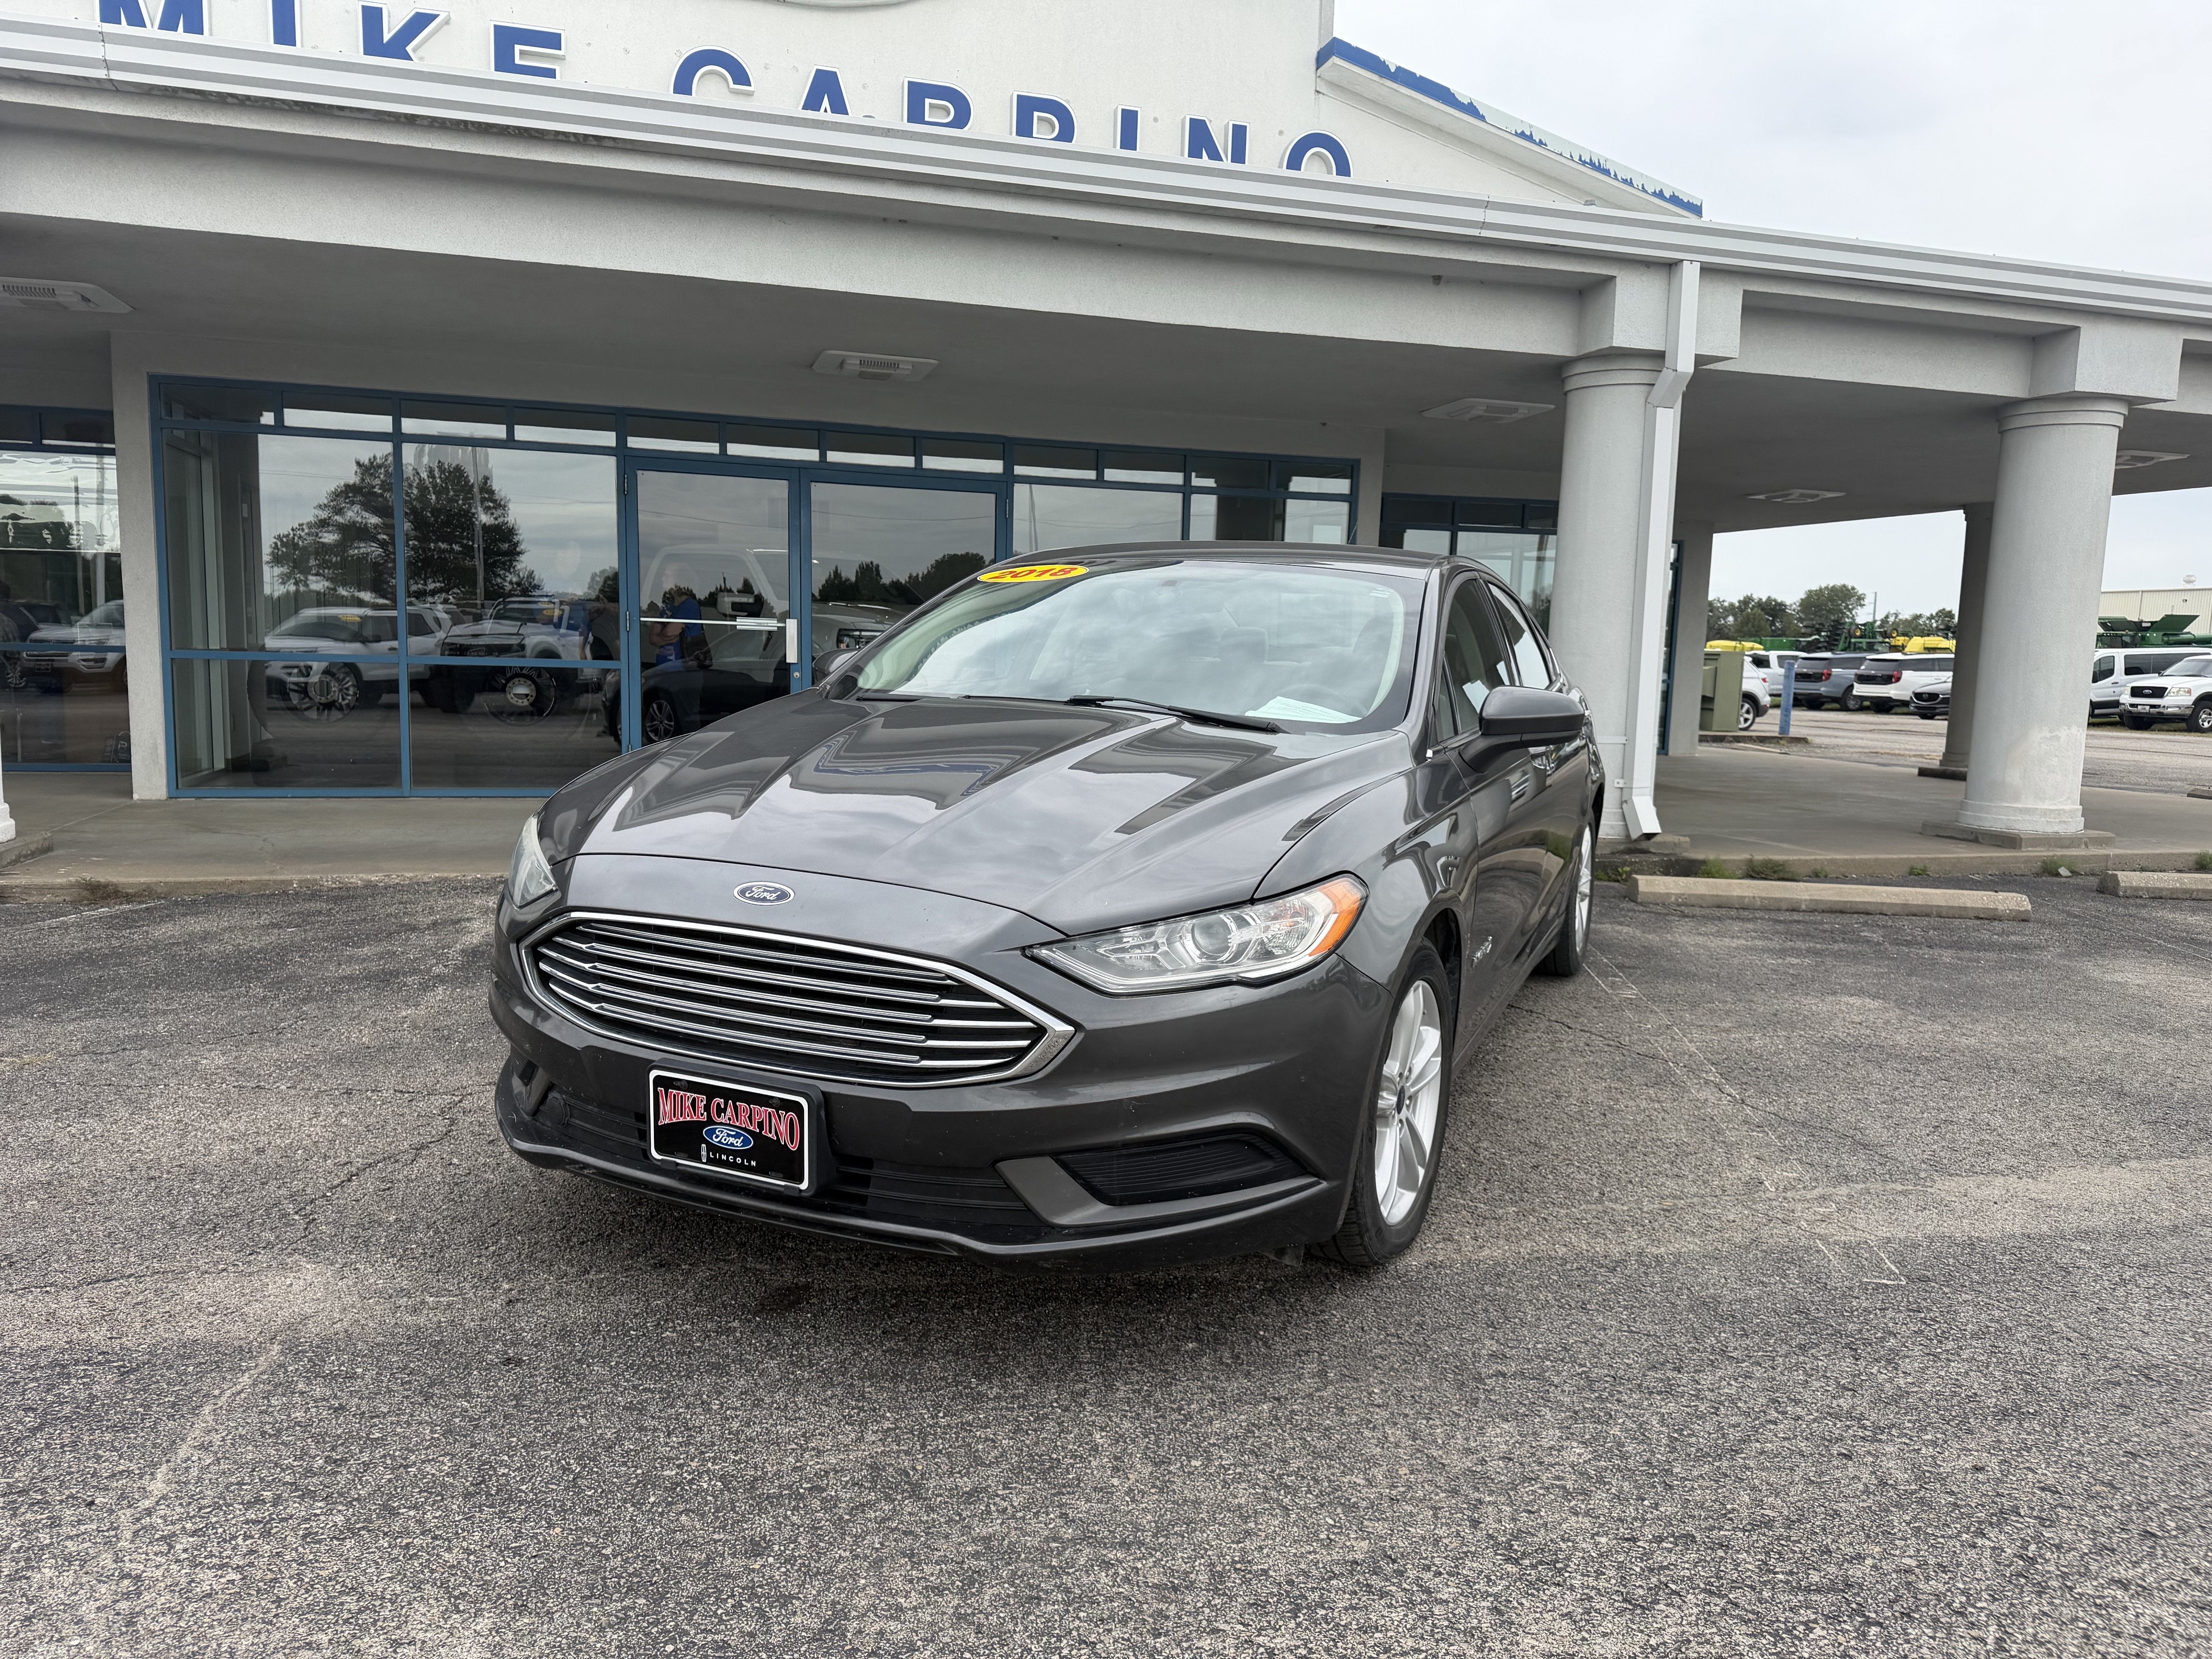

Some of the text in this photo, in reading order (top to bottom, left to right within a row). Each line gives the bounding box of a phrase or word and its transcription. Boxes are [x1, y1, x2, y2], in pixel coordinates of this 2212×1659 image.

[986, 567, 1078, 580] 2018
[745, 886, 781, 900] Ford
[658, 1087, 800, 1151] MIKE CARPINO
[713, 1128, 744, 1146] Ford
[710, 1152, 756, 1167] LINCOLN
